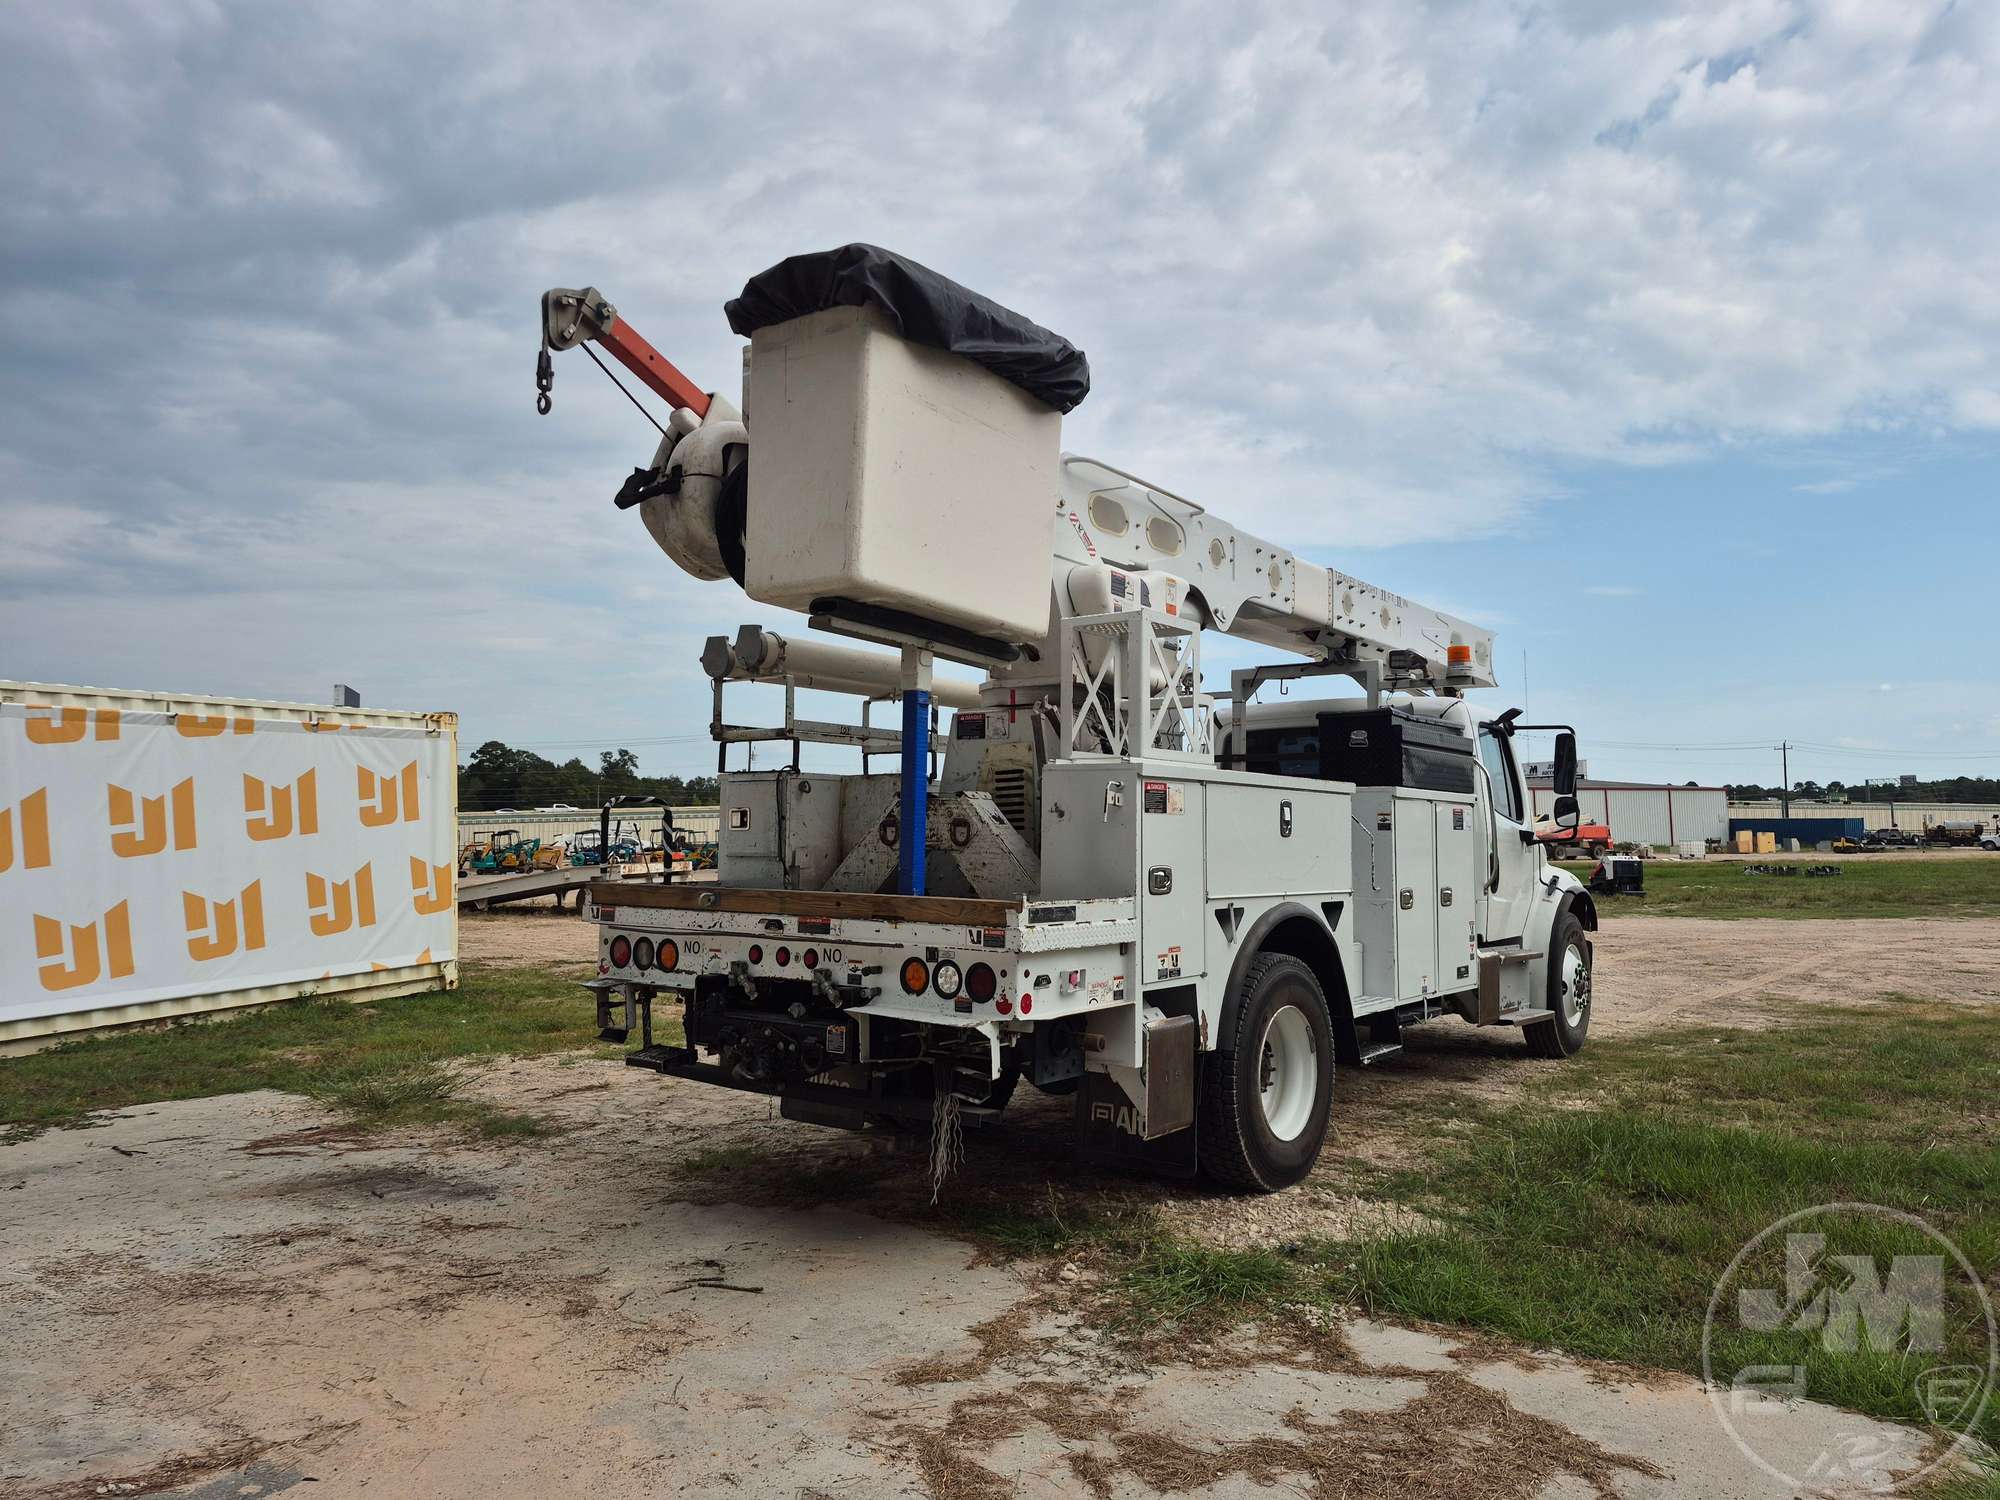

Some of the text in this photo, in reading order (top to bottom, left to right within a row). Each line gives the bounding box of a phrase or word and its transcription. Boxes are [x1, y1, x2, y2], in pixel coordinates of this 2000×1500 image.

[683, 940, 701, 955] NO
[822, 947, 842, 963] NO
[1116, 1105, 1147, 1137] Alt
